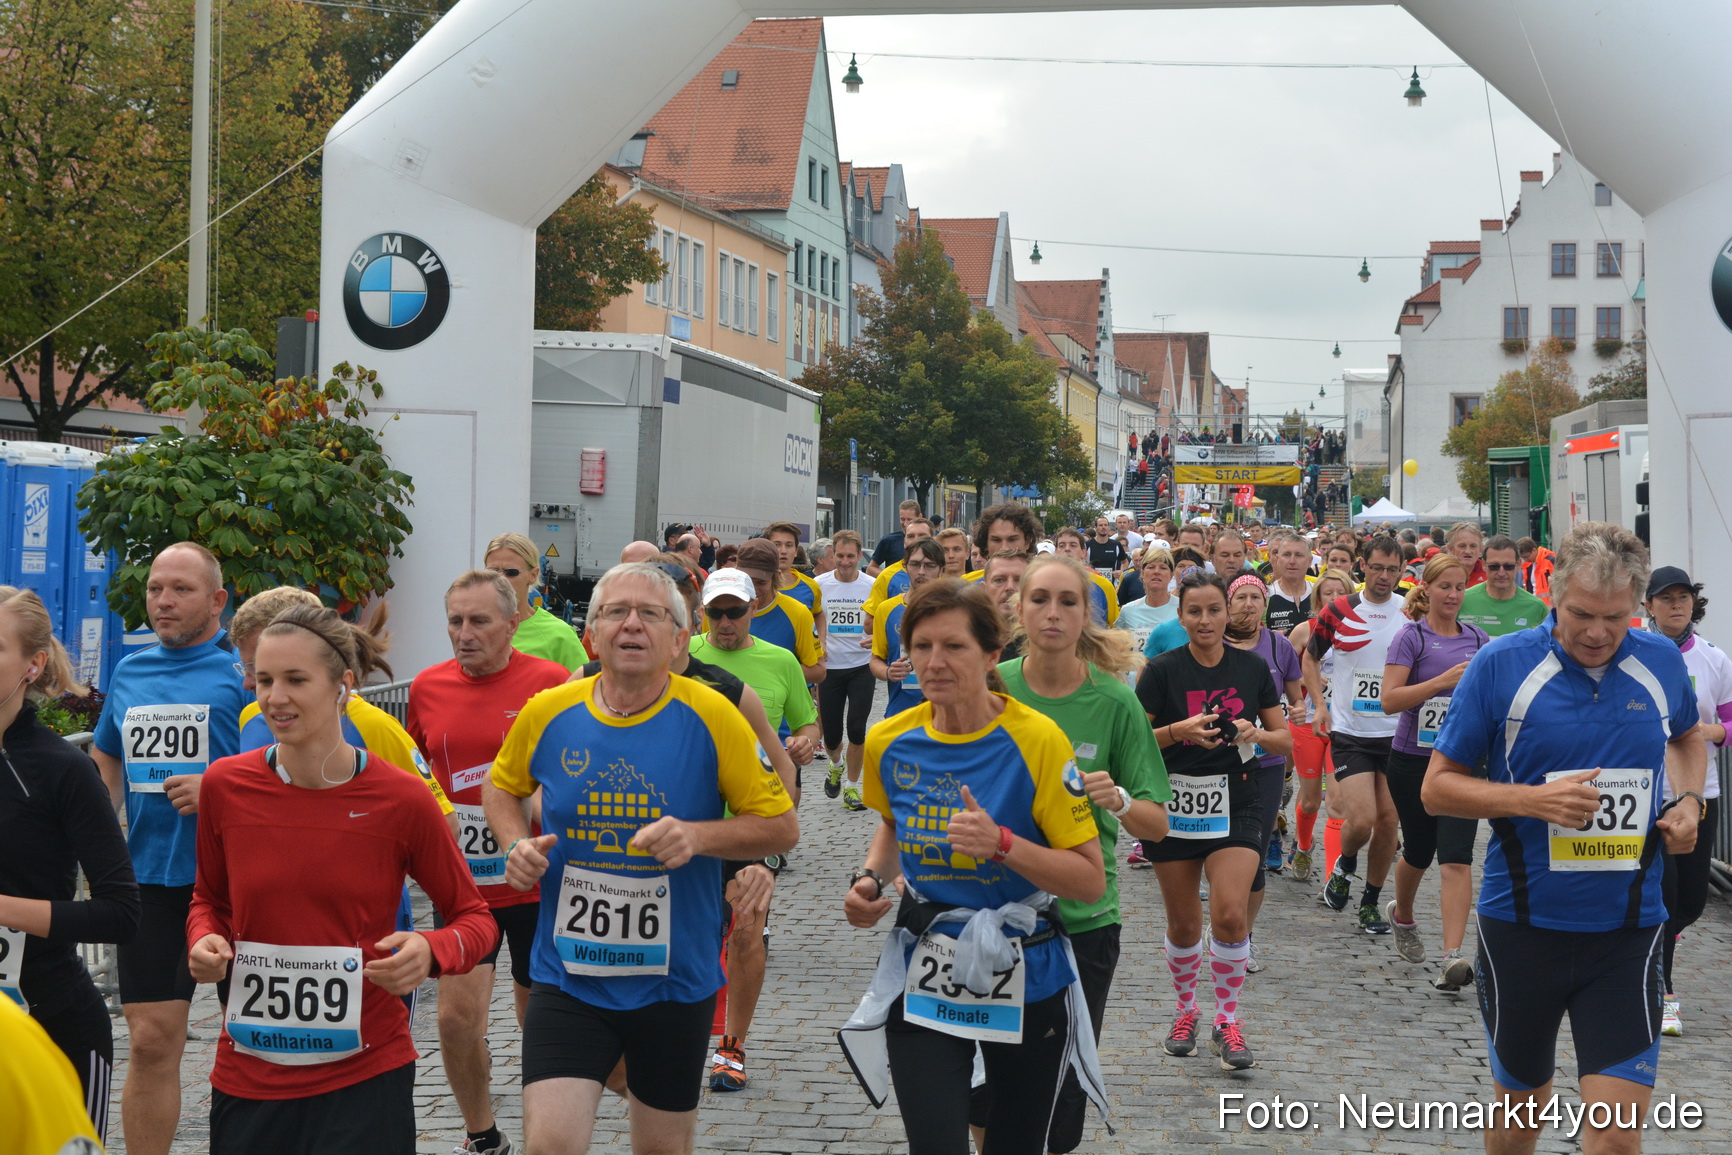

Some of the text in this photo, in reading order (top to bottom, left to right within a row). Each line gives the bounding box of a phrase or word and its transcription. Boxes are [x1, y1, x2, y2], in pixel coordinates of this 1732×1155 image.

[350, 235, 442, 275] BMW
[784, 433, 814, 477] BOCK
[1215, 469, 1259, 480] START
[831, 611, 861, 625] 2561
[1358, 680, 1381, 699] 26
[126, 713, 192, 722] PARTL Neumarkt
[130, 725, 199, 758] 2290
[1185, 781, 1217, 790] Neumarkt
[1589, 779, 1639, 789] Neumarkt
[1168, 789, 1223, 815] 3392
[1576, 793, 1639, 832] 32
[579, 820, 638, 830] 21.September
[1172, 816, 1211, 832] Kerstin
[1572, 841, 1639, 859] Wolfgang
[563, 876, 652, 899] PARTL Neumarkt
[566, 894, 660, 940] 2616
[236, 953, 338, 971] PARTL Neumarkt
[574, 943, 645, 966] Wolfgang
[240, 973, 349, 1023] 2569
[936, 1003, 990, 1025] Renate
[251, 1030, 334, 1050] Katharina
